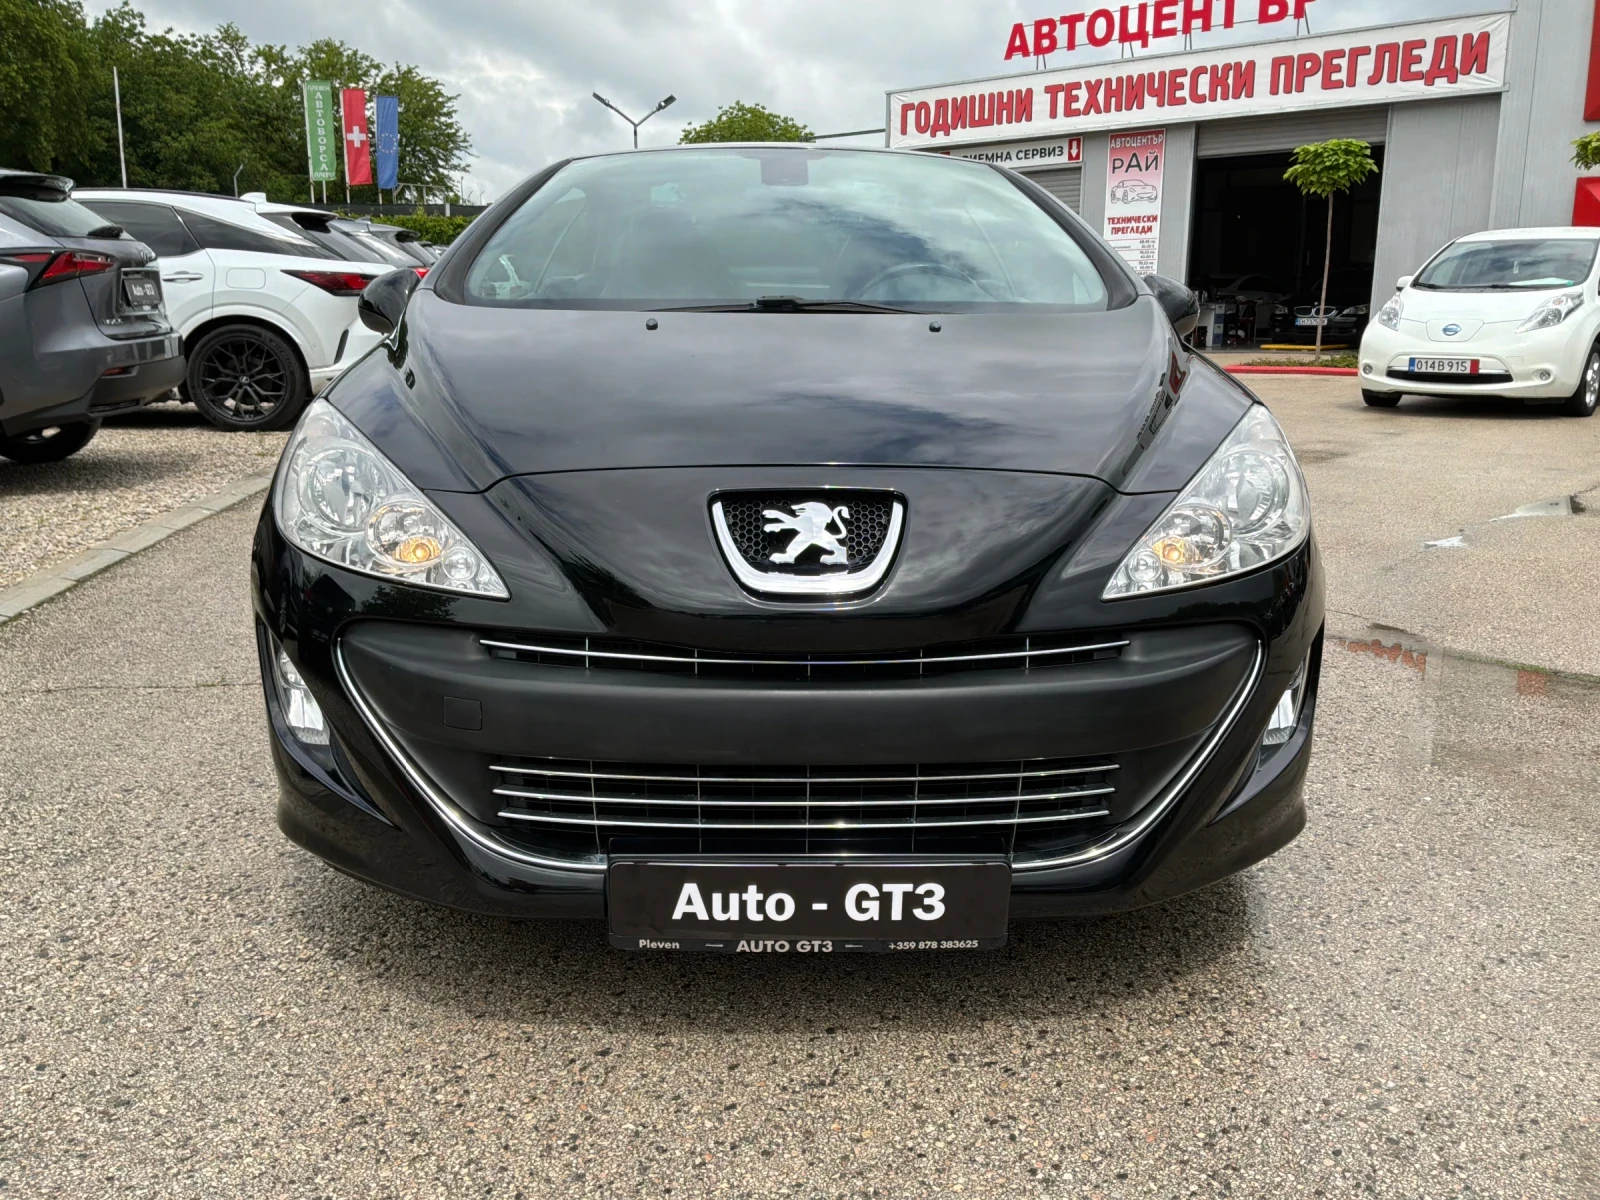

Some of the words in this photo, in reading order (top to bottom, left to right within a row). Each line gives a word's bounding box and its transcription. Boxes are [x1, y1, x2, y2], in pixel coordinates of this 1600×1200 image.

[900, 87, 1033, 138] ГОДИШНИ
[1044, 60, 1256, 119] ТЕХНИЧЕСКИ
[1269, 31, 1490, 96] ПРЕГЛЕДИ
[1110, 135, 1163, 148] АВТОЦЕНТЪР
[1016, 146, 1064, 160] СЕРВИЗ
[1107, 215, 1158, 225] ТЕХНИЧЕСКИ
[1111, 225, 1153, 235] ПРЕГЛЕДИ
[671, 882, 796, 922] Auto
[812, 902, 828, 911] -
[844, 882, 946, 922] GT3
[638, 939, 680, 950] Pleven
[736, 940, 790, 953] AUTO
[796, 940, 833, 953] GT3
[888, 940, 915, 950] +359
[918, 940, 938, 950] 878
[940, 939, 979, 950] 383625
